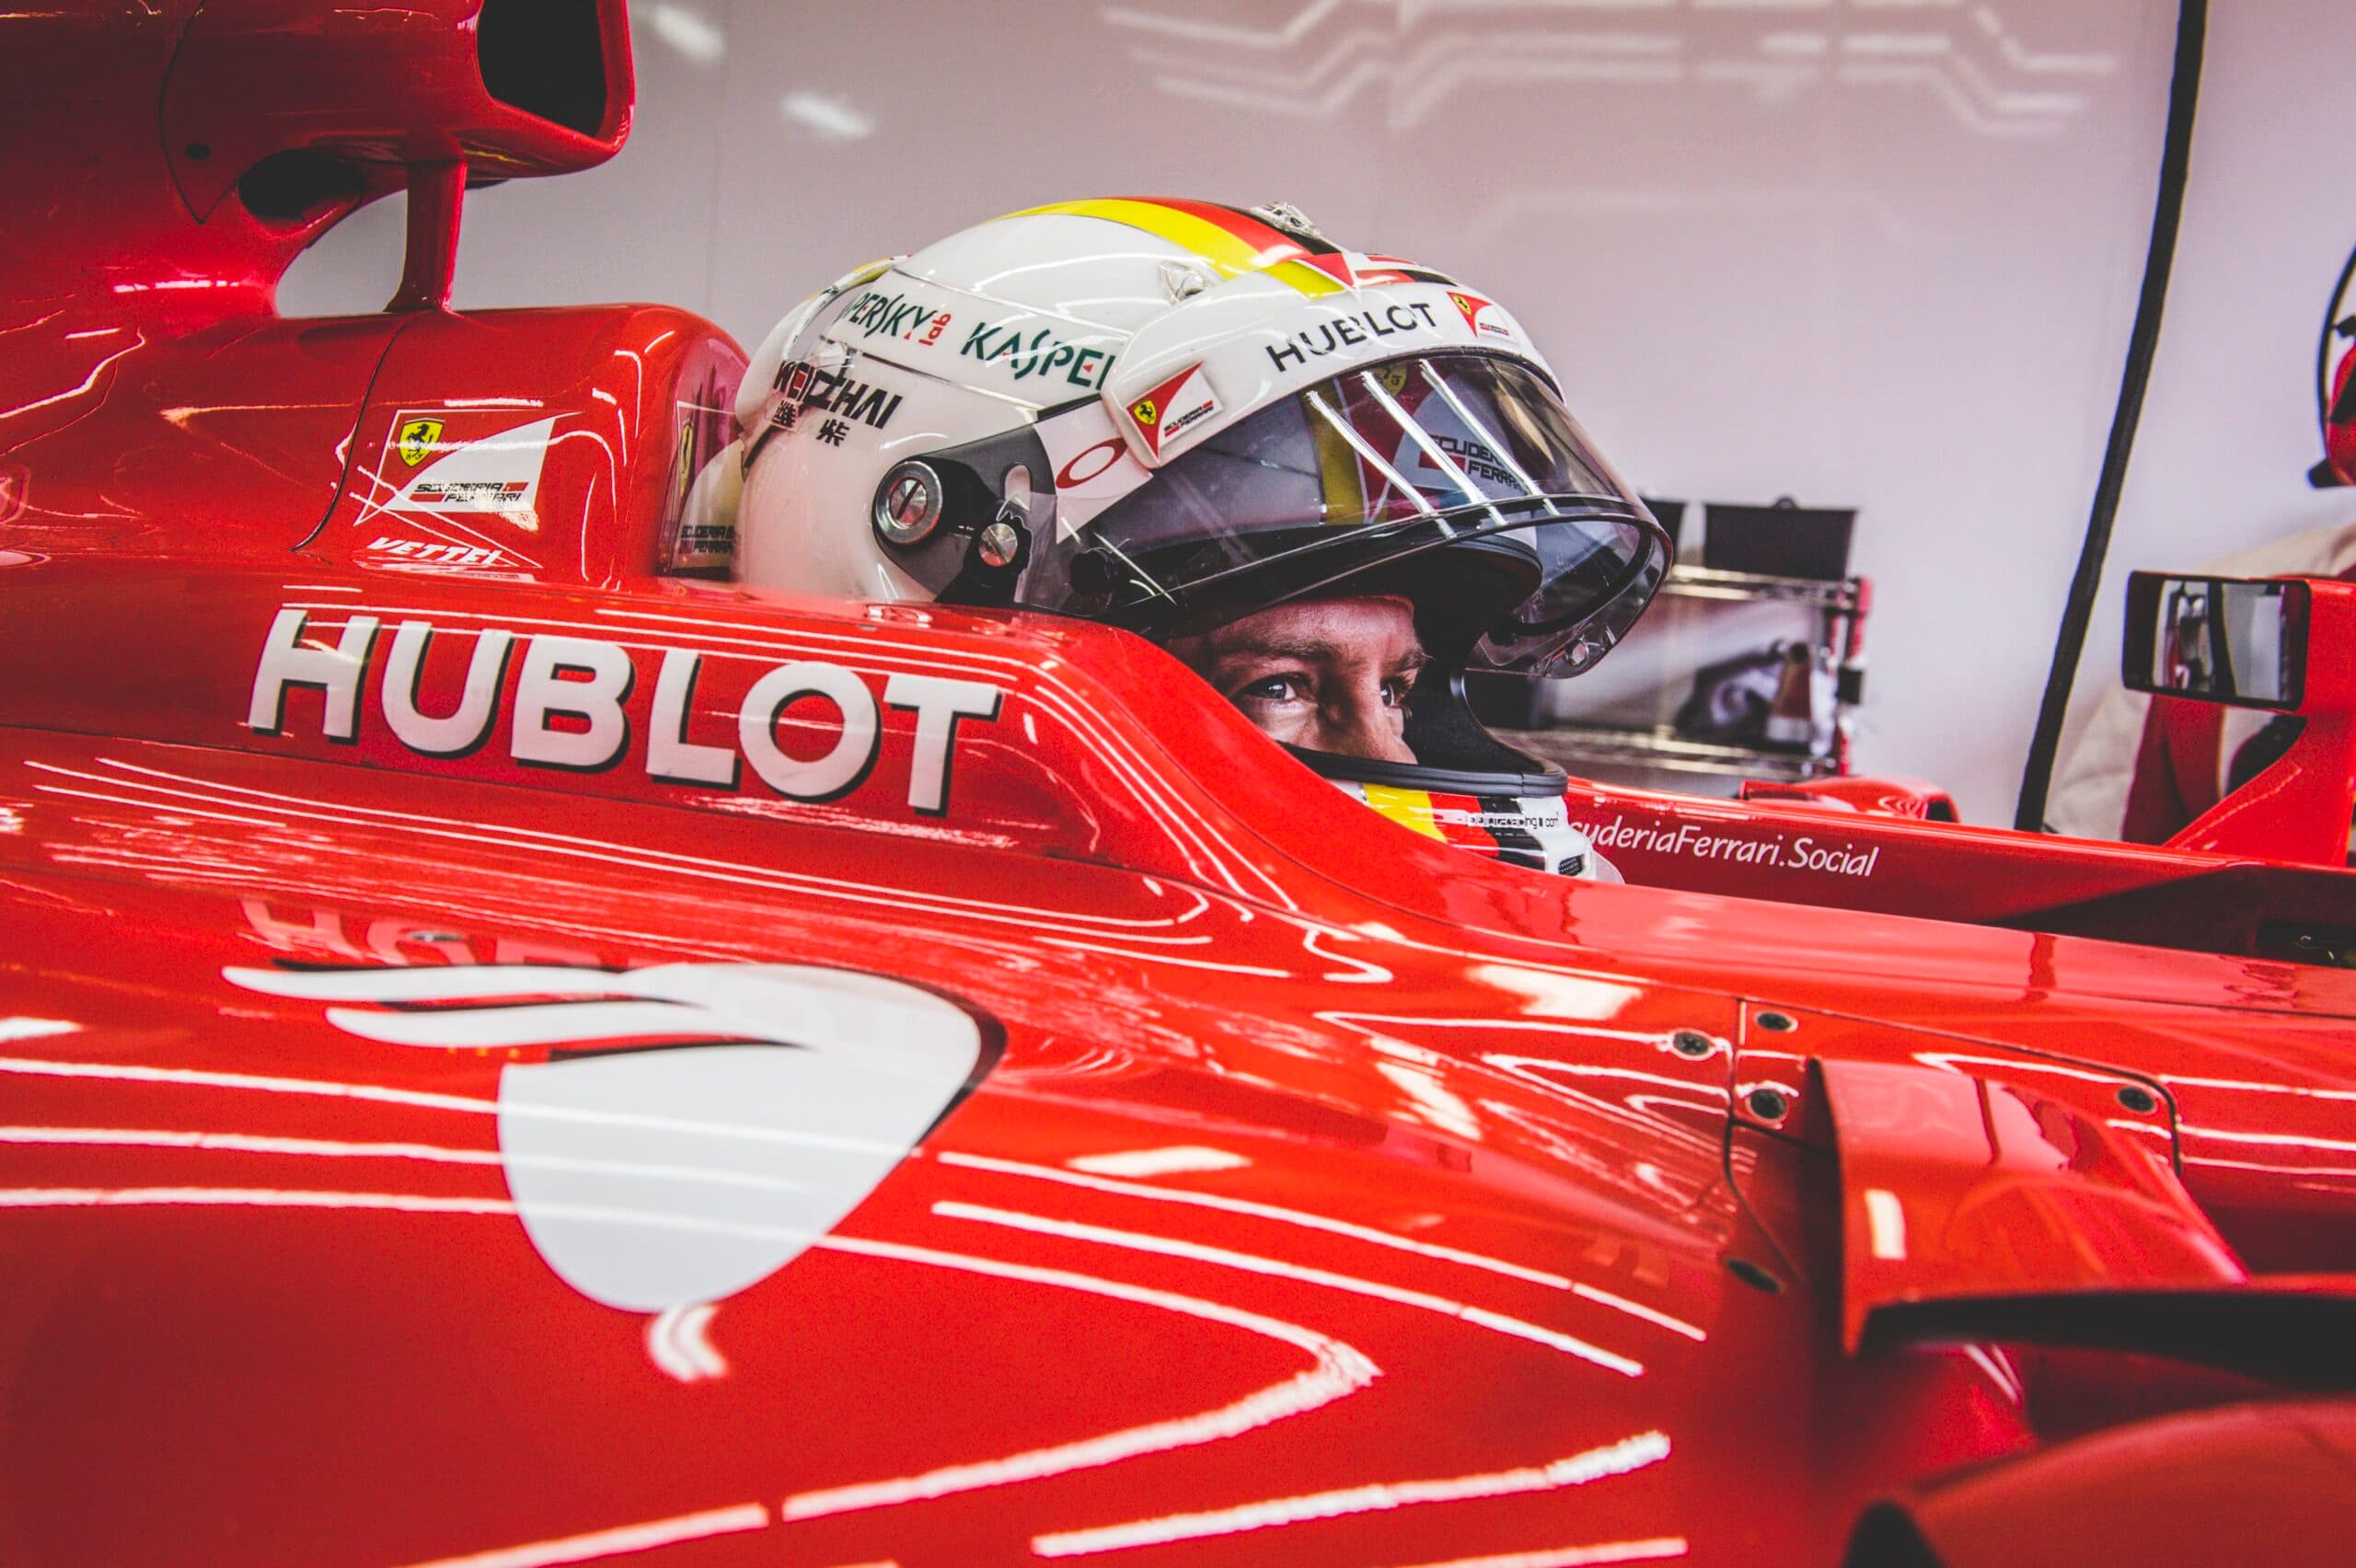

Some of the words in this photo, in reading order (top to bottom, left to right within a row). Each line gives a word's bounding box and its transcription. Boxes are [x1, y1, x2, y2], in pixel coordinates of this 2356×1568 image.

[834, 292, 939, 340] PERSKY
[918, 313, 952, 347] lab
[1265, 302, 1437, 373] HUBLOT
[443, 492, 522, 502] FEARI
[248, 608, 1003, 815] HUBLOT
